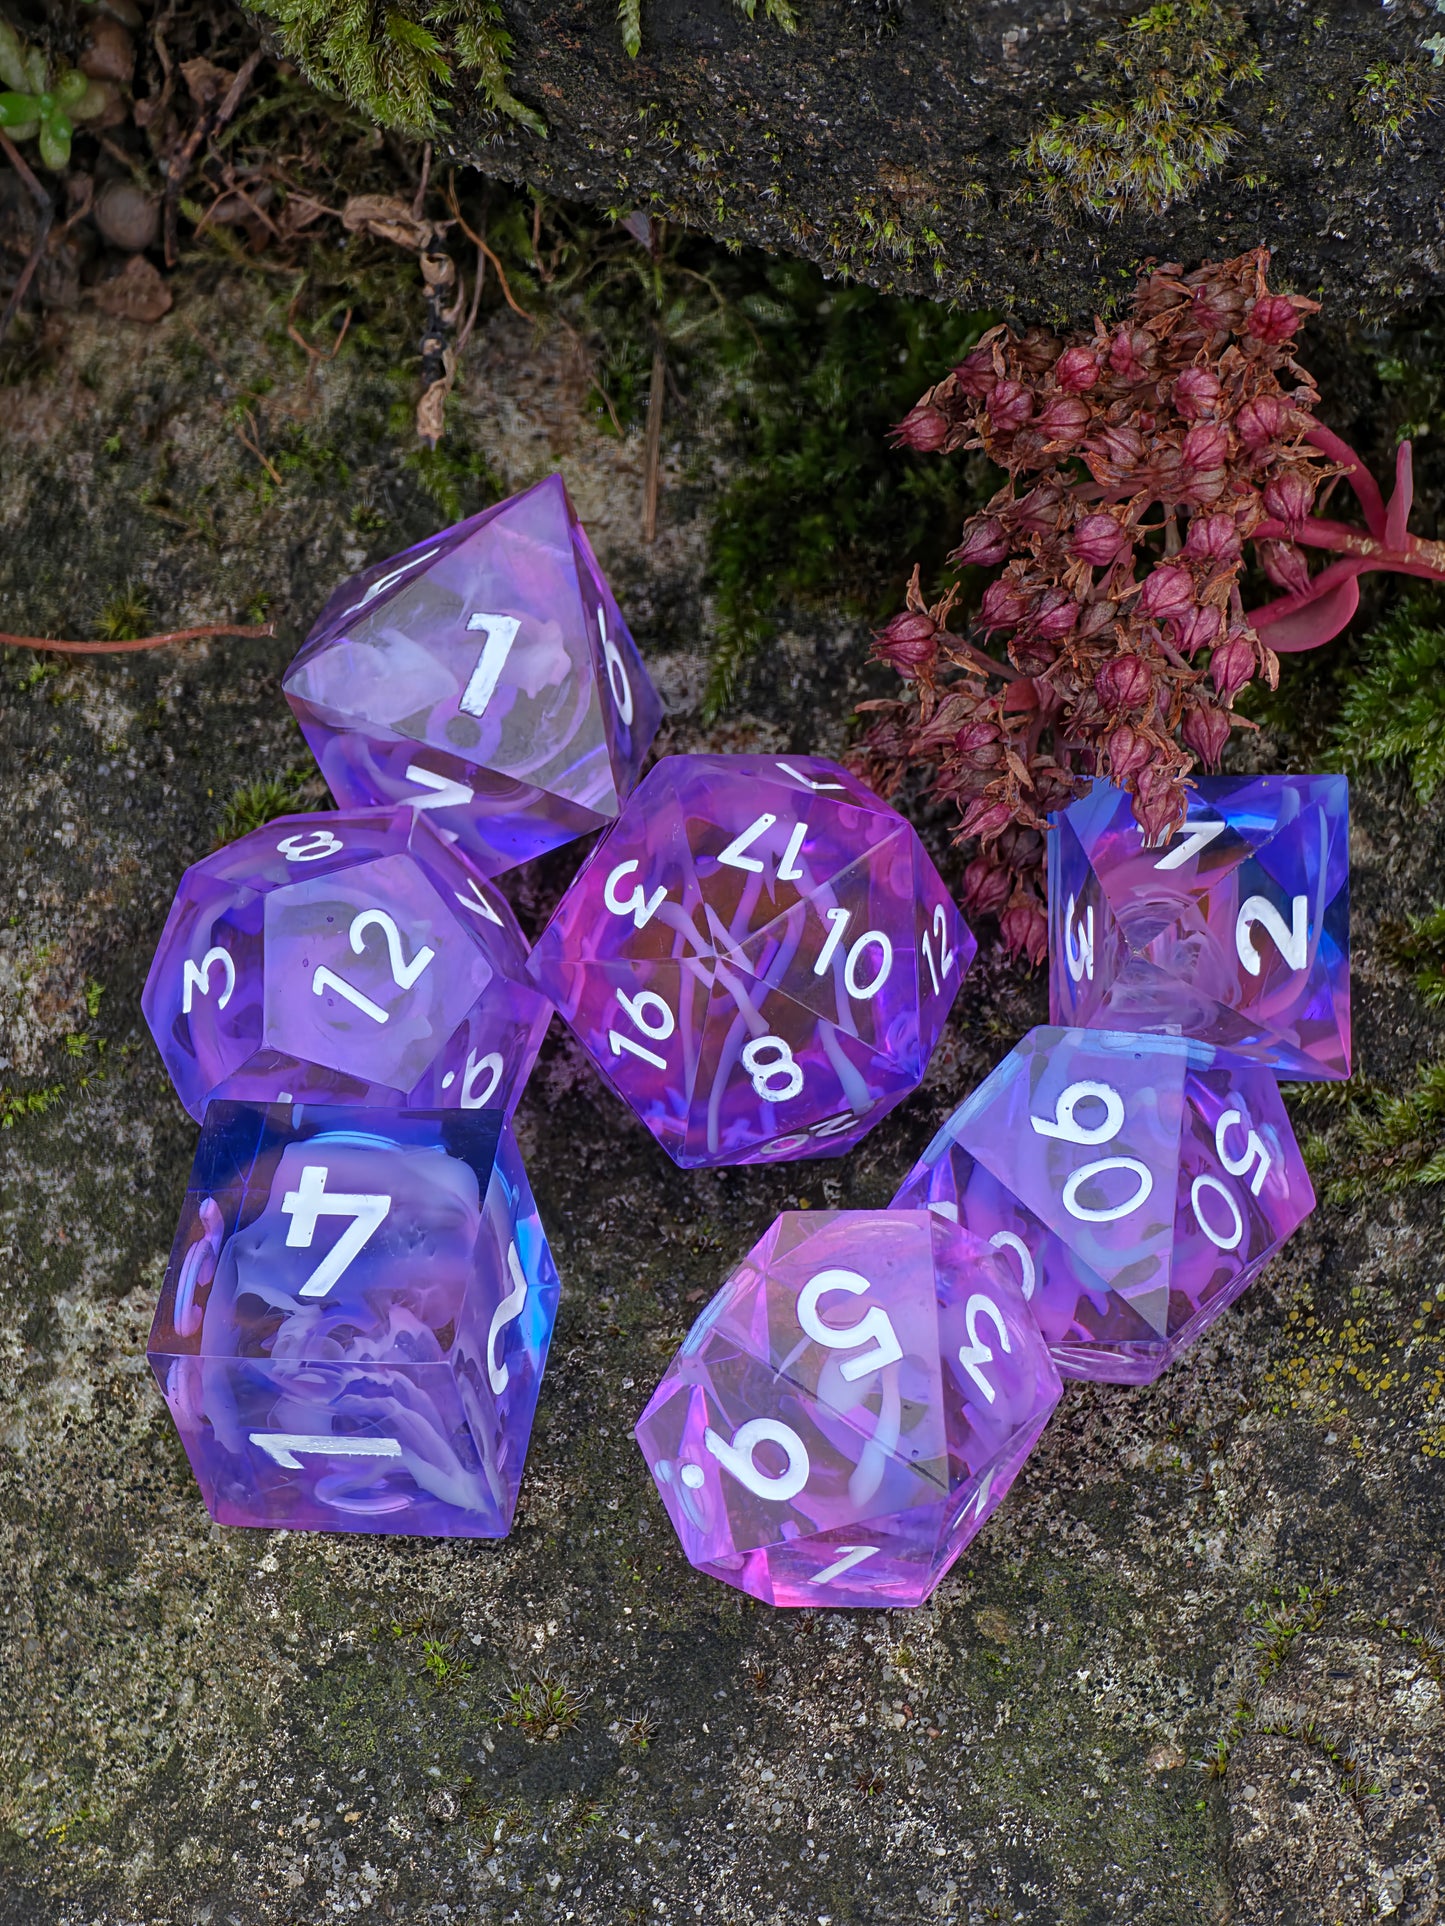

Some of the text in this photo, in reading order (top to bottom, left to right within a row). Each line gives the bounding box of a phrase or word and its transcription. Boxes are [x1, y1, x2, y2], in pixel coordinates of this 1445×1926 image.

[458, 611, 522, 719] 1
[276, 831, 344, 862] 8
[717, 813, 809, 880] 17
[603, 859, 668, 929] 3
[1235, 894, 1308, 977] 2
[182, 946, 236, 1015] 3
[312, 909, 436, 1025] 12
[813, 907, 893, 999] 10
[922, 903, 954, 996] 12
[607, 986, 676, 1070] 16
[741, 1035, 804, 1102] 8
[1190, 1109, 1272, 1250] 50
[280, 1165, 392, 1297] 4
[797, 1268, 904, 1383] 5
[958, 1293, 1011, 1405] 3
[248, 1432, 403, 1470] 1
